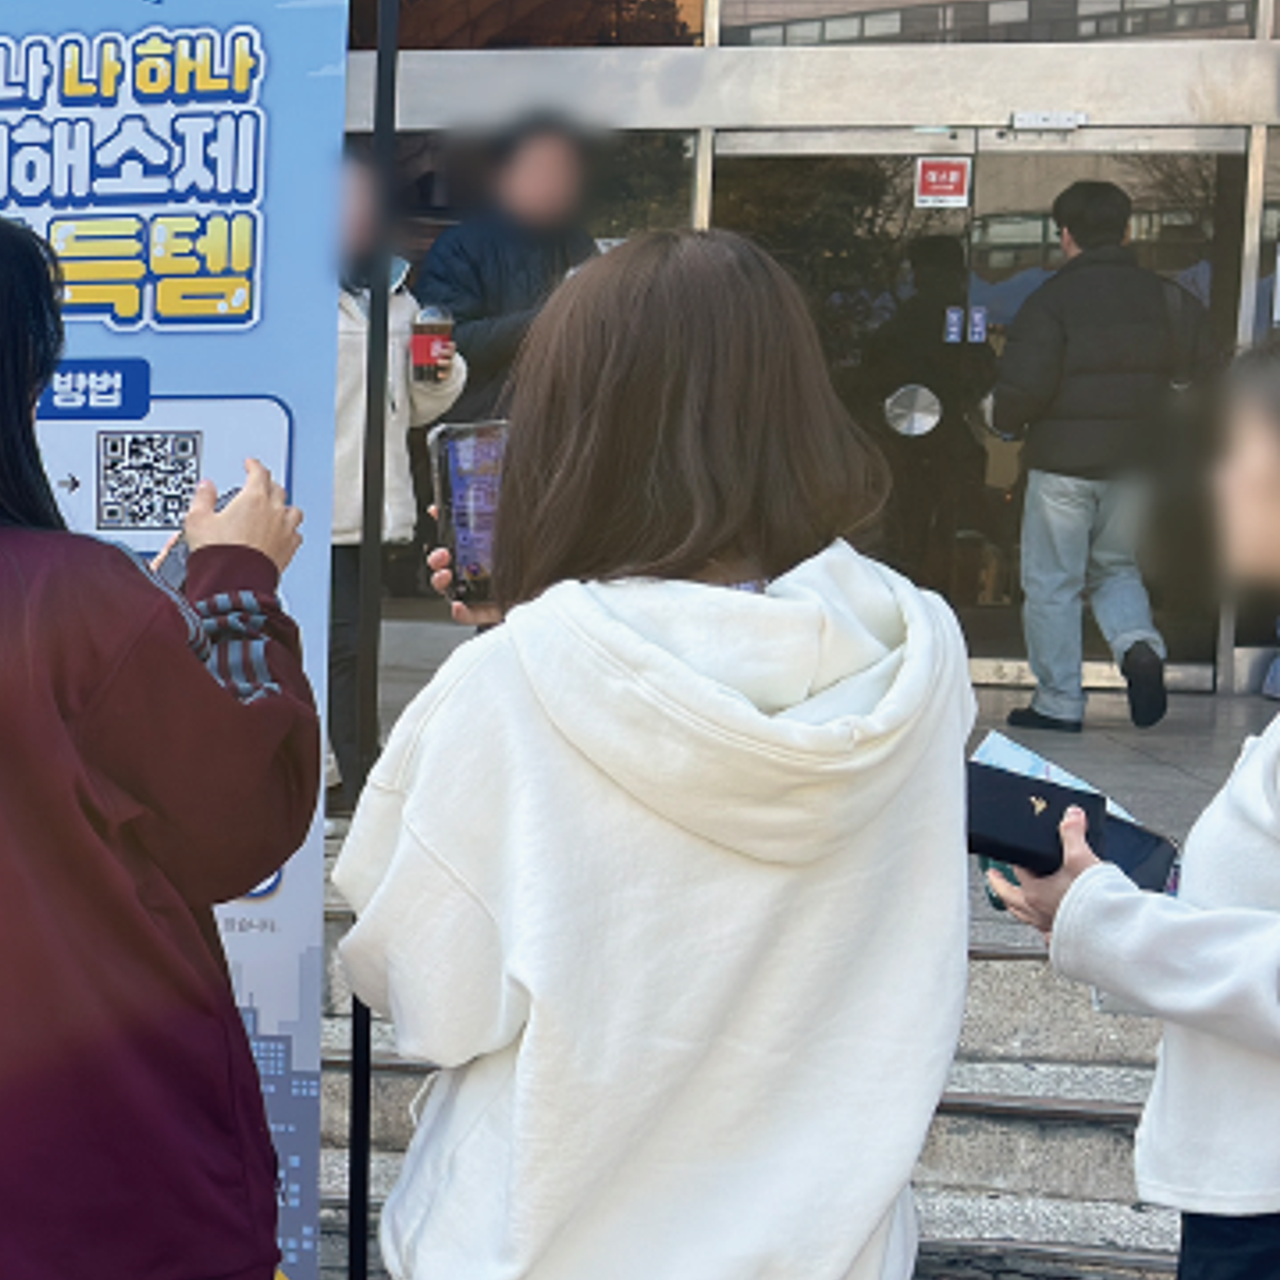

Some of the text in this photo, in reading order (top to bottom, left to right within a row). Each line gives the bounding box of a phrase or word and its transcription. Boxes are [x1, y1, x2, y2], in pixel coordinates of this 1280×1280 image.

[59, 38, 123, 105] 나
[133, 32, 258, 103] 하나
[53, 372, 122, 407] 방법
